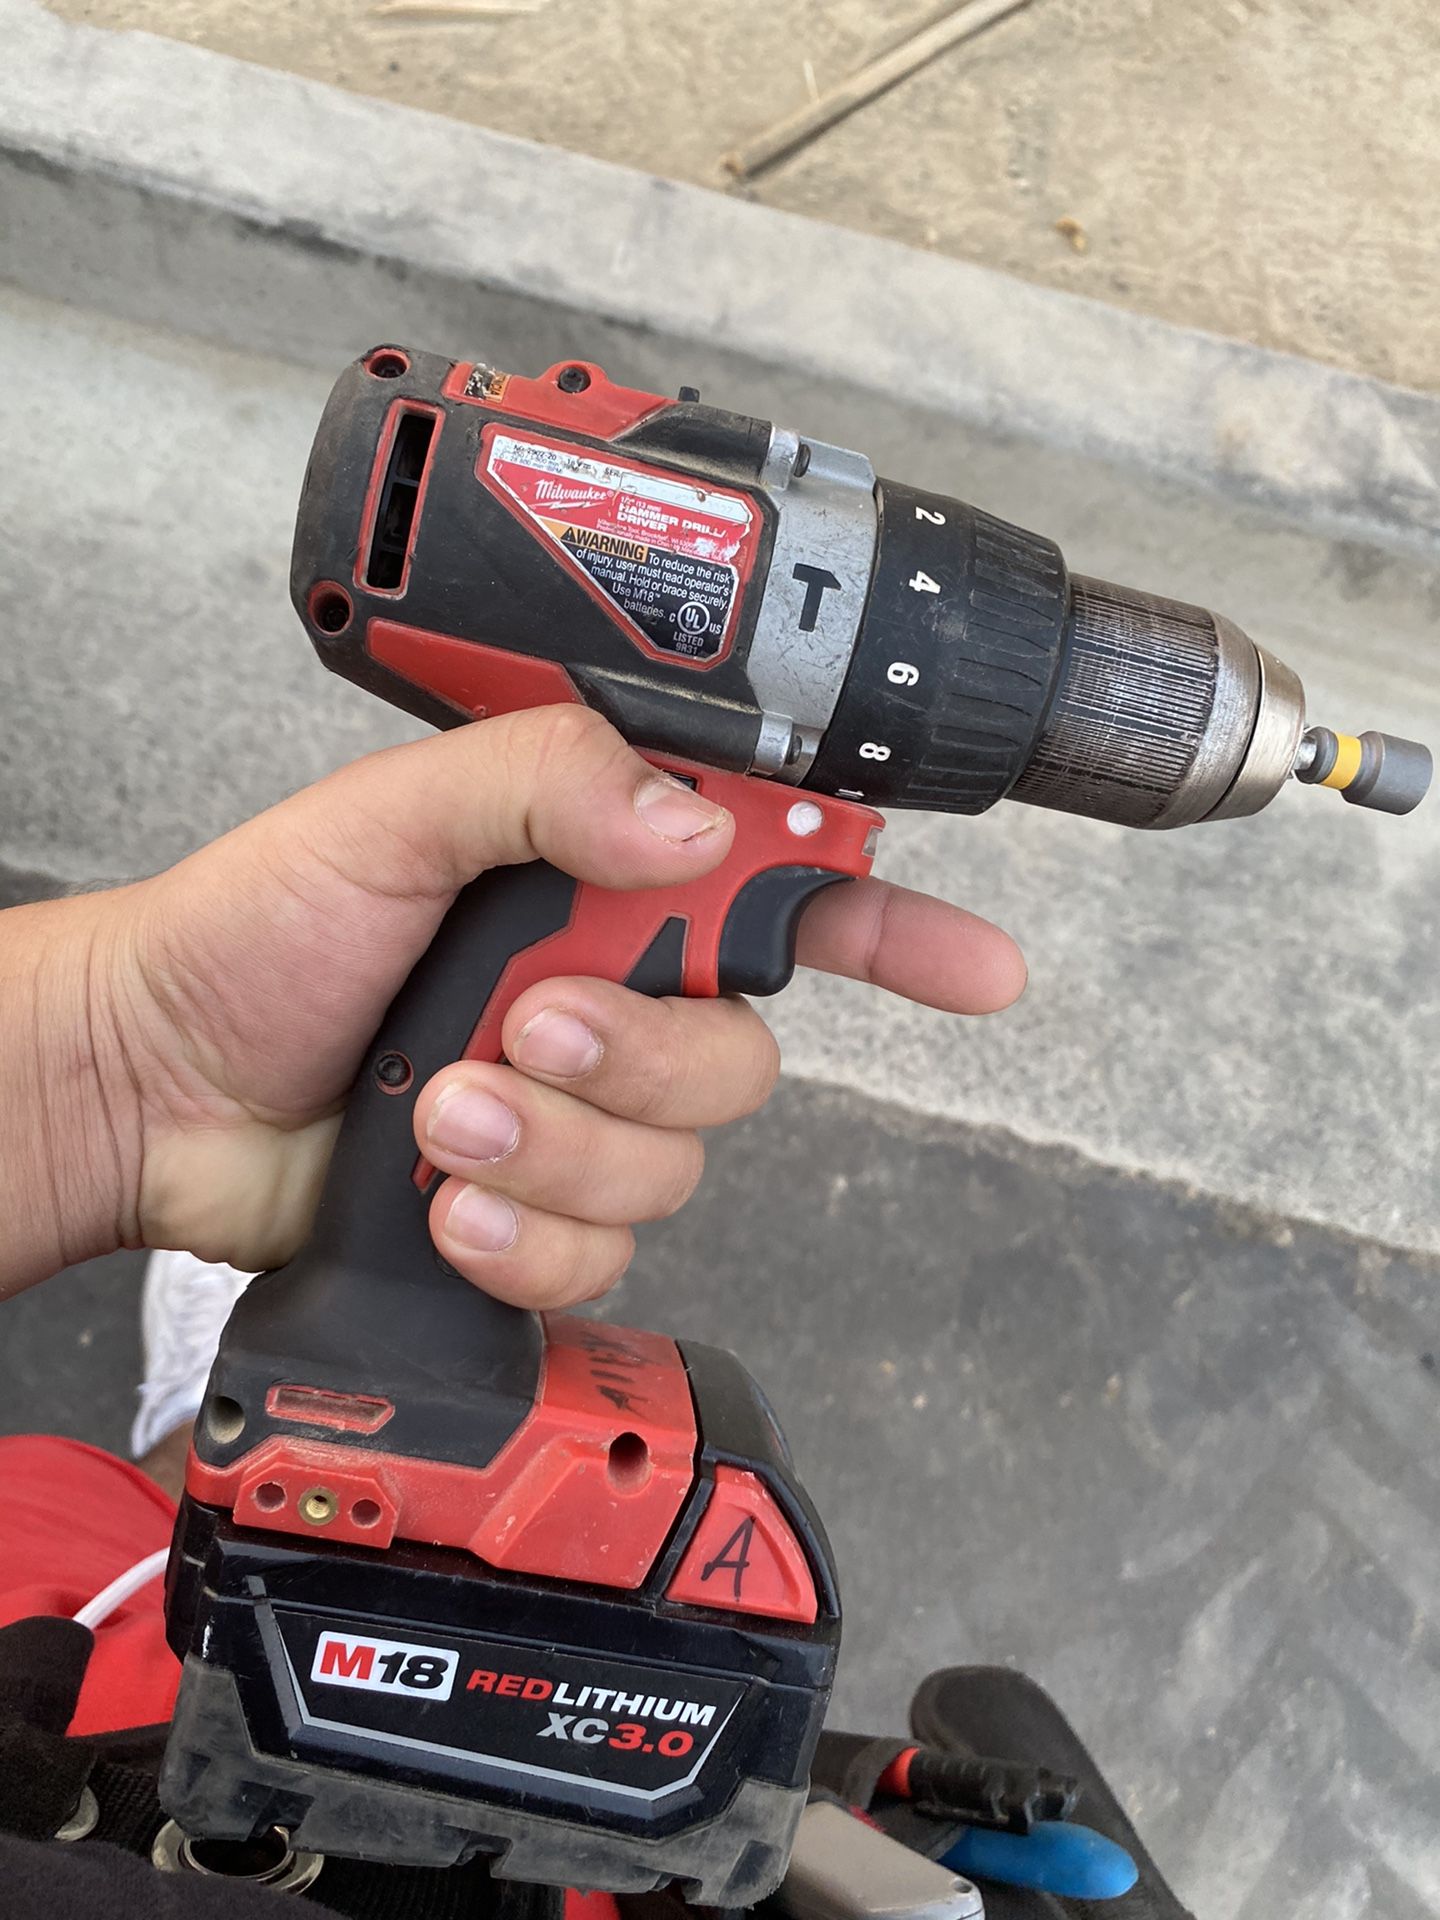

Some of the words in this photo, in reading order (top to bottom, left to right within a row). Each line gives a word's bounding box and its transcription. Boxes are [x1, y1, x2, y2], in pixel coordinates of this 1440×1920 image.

[534, 479, 607, 500] Milwaukee
[616, 511, 668, 532] DRIVER
[618, 503, 679, 526] HAMMER
[915, 506, 946, 525] 2
[574, 529, 646, 560] WARNING
[647, 552, 661, 566] To
[661, 557, 695, 575] reduce
[696, 566, 712, 579] the
[713, 570, 732, 584] risk
[575, 547, 587, 559] of
[586, 550, 615, 569] injury,
[615, 559, 637, 572] user
[637, 564, 661, 579] must
[661, 570, 684, 585] read
[683, 576, 730, 598] operator's
[909, 571, 941, 595] 4
[590, 565, 628, 583] manual.
[628, 574, 651, 589] Hold
[650, 582, 661, 591] or
[661, 582, 689, 598] brace
[687, 590, 729, 611] securely.
[611, 582, 632, 597] Use
[623, 598, 667, 618] batteries.
[673, 632, 704, 647] LISTED
[887, 661, 920, 687] 6
[859, 742, 891, 761] 8
[701, 1515, 756, 1600] A
[320, 1640, 449, 1690] M18
[466, 1669, 717, 1727] REDLITHIUM
[536, 1712, 694, 1758] XC3.0
